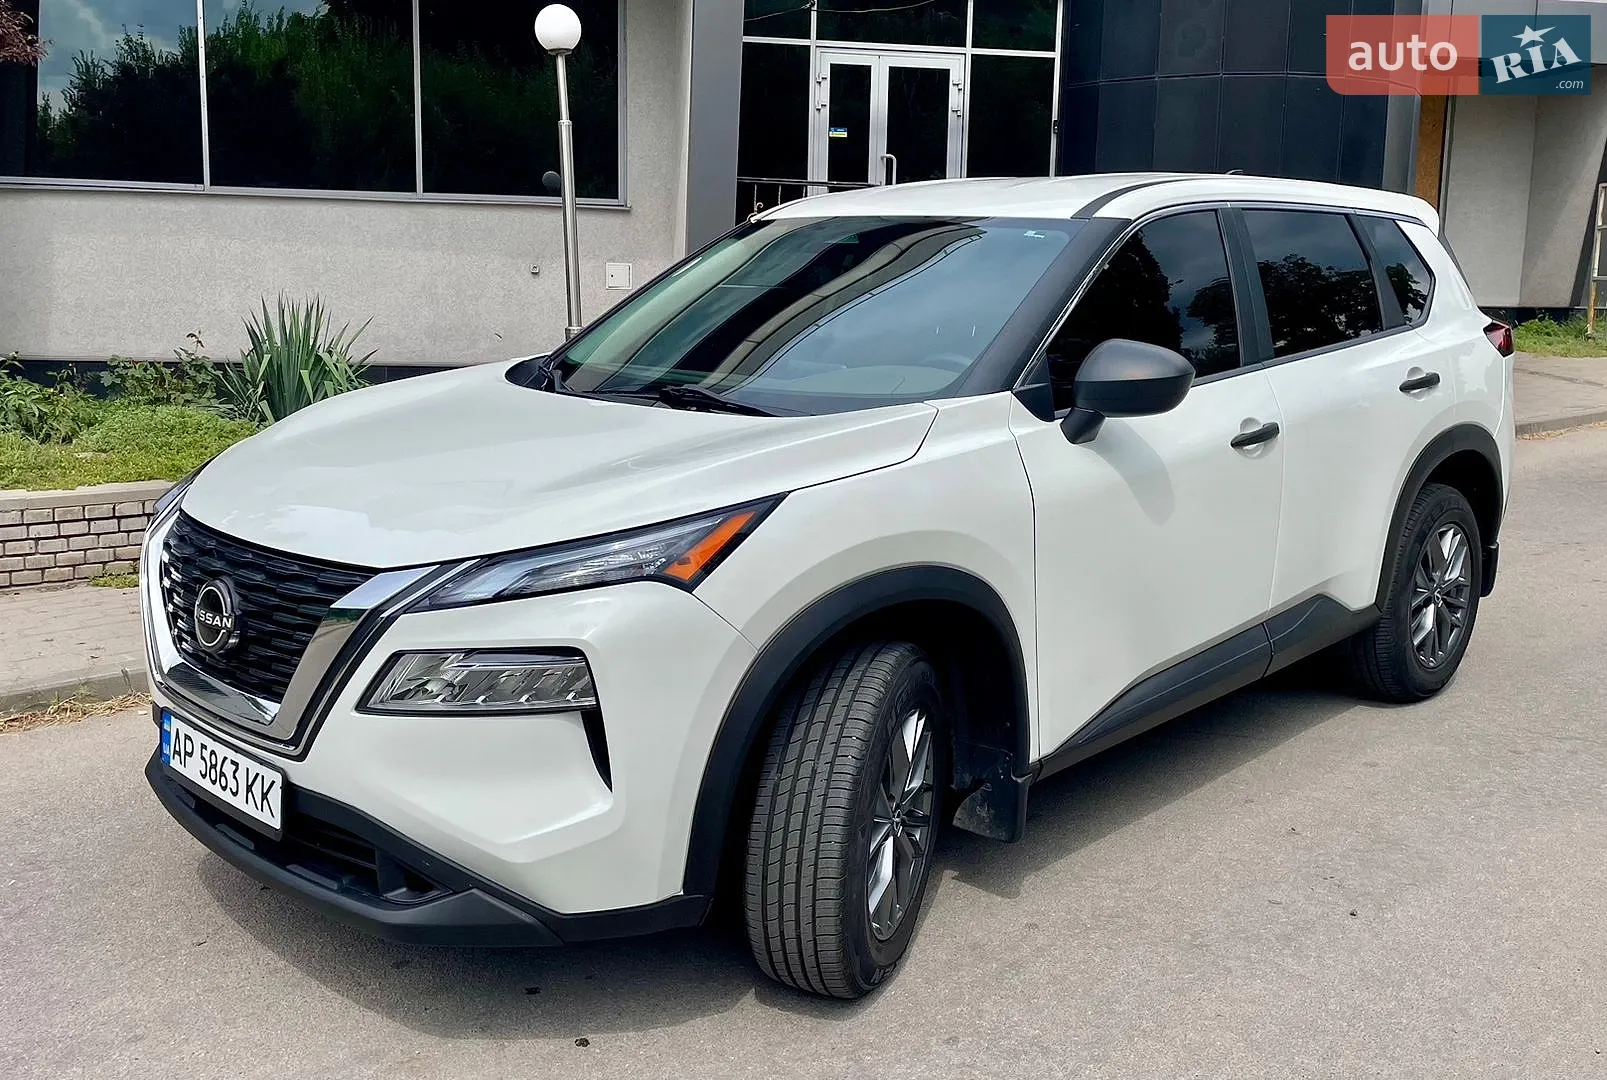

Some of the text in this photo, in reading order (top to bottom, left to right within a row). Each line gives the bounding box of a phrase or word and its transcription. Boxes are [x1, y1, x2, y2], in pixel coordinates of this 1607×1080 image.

[196, 608, 232, 628] ISSAN
[172, 727, 276, 819] AP 5863 KK
